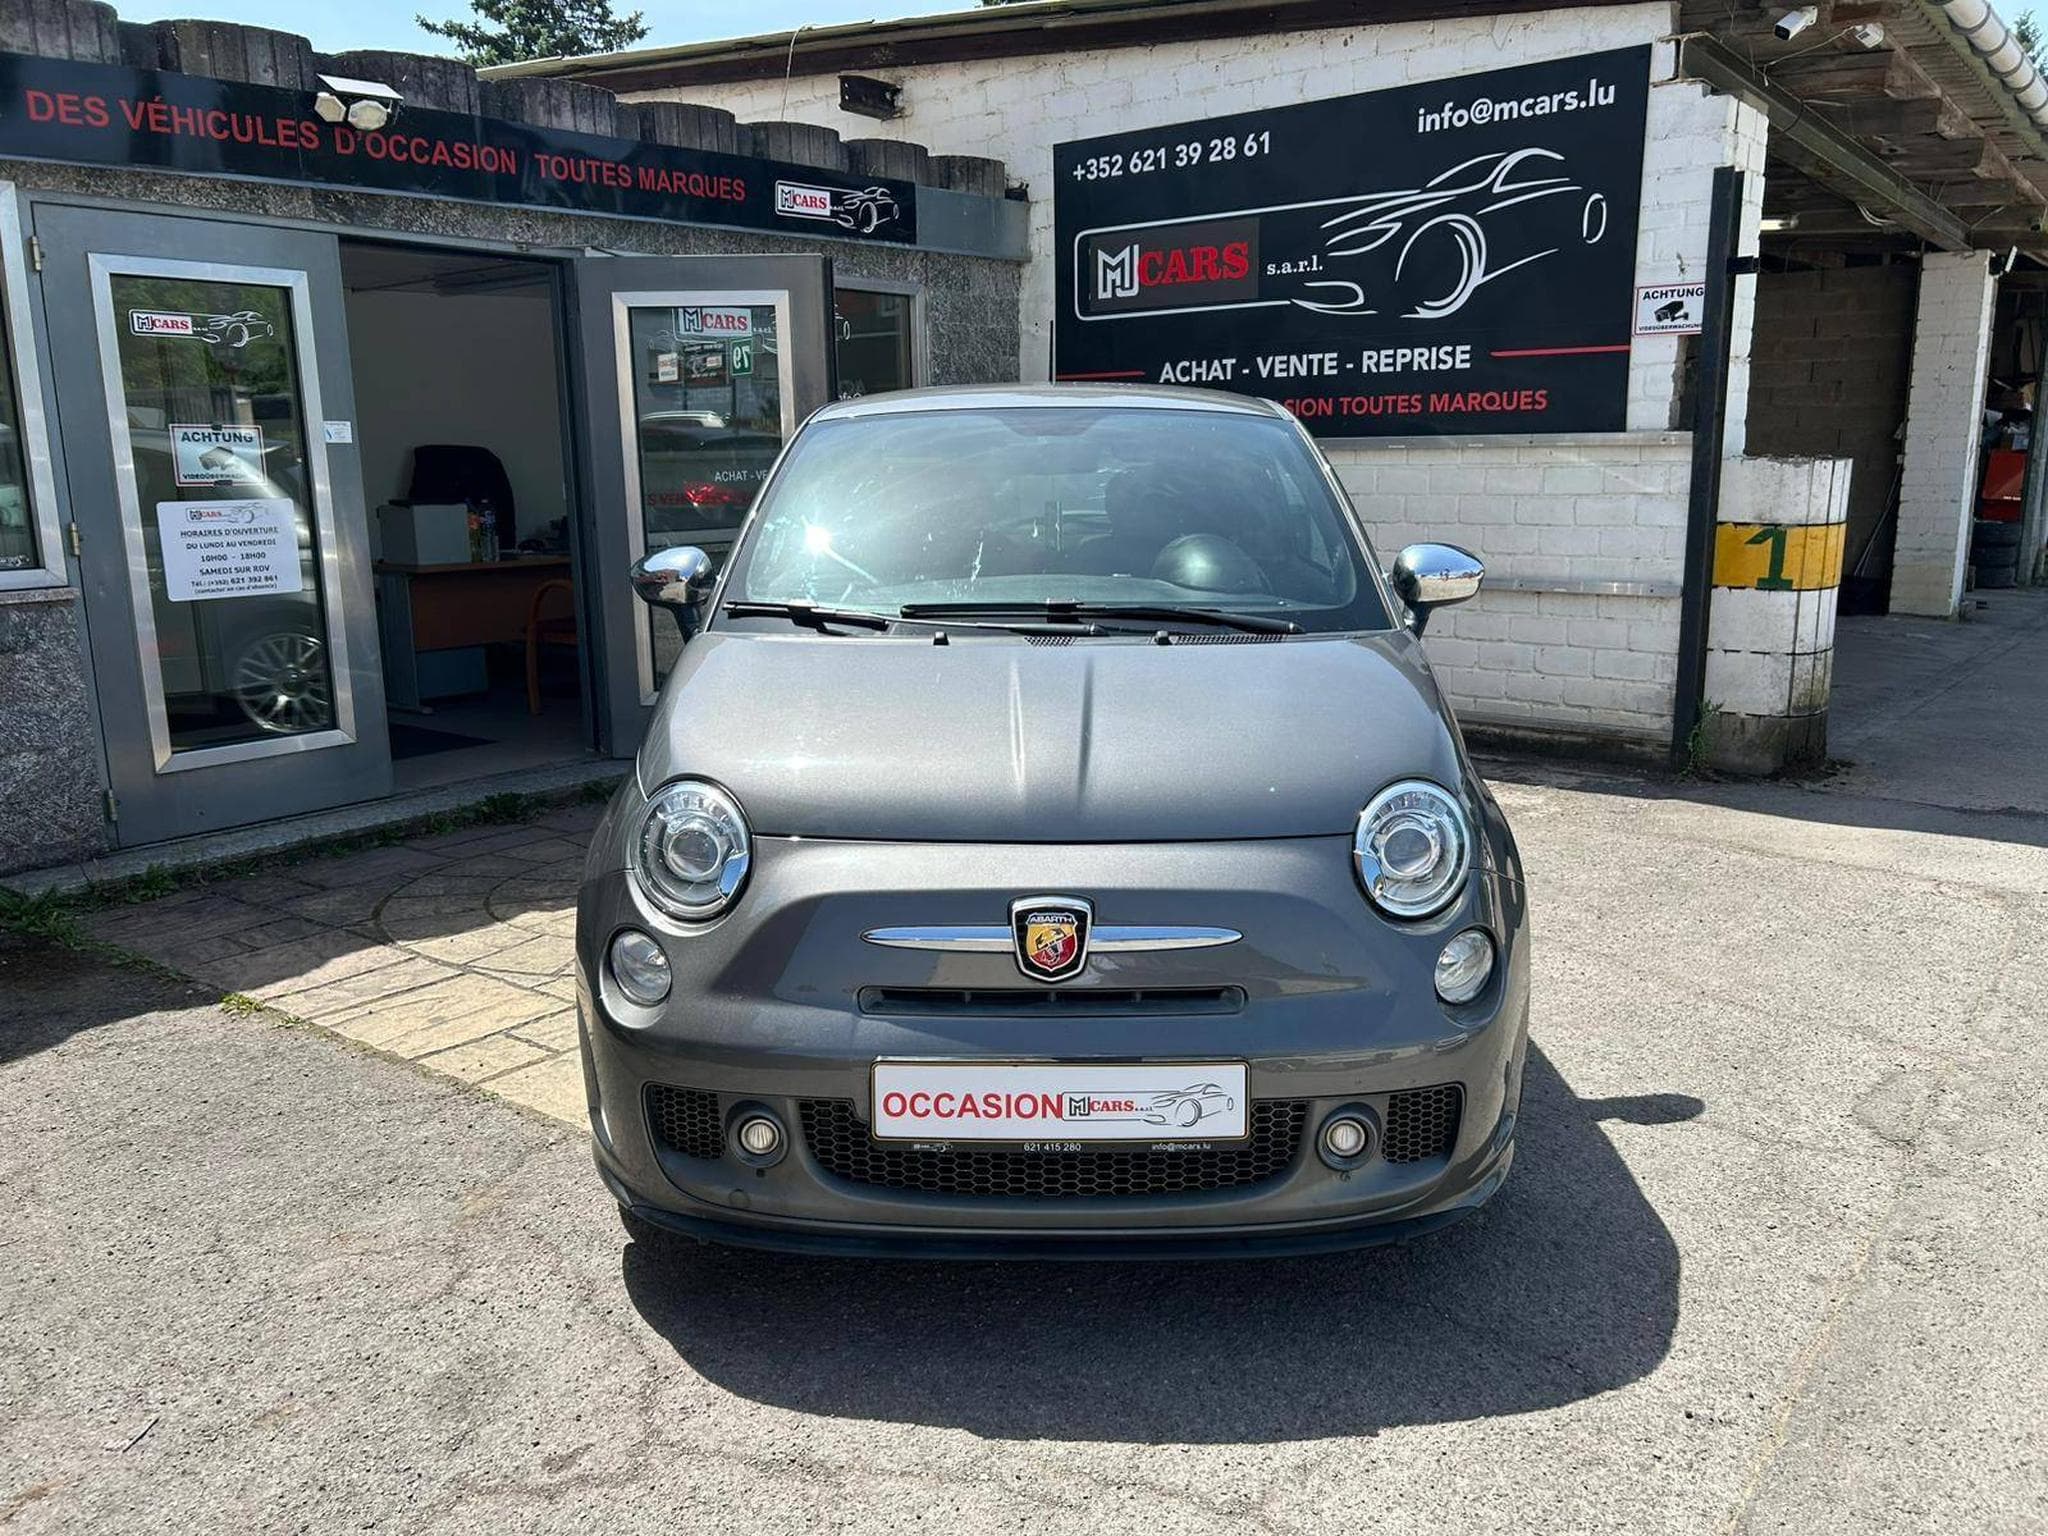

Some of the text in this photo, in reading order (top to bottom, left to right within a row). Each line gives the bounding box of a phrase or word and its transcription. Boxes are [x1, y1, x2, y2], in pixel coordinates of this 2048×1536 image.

[1417, 78, 1616, 133] info@mcars.lu
[25, 90, 747, 201] DES VÉHICULES D'OCCASION TOUTES MARQUES
[1073, 131, 1271, 181] +352 621 39 28 61
[1266, 254, 1324, 276] s.a.r.l.
[1642, 286, 1704, 301] ACHTUNG
[1158, 358, 1237, 384] ACHAT
[1256, 352, 1339, 379] VENTE
[1361, 344, 1472, 374] REPRISE
[1339, 394, 1422, 416] TOUTES
[1429, 389, 1549, 413] MARQUES
[180, 431, 254, 444] ACHTUNG
[714, 469, 748, 482] ACHAT
[180, 526, 279, 538] HORAIRES D'OUVERTURE
[186, 538, 276, 550] DU LUNDI AU VENDREDI
[201, 554, 228, 562] 10H00
[1744, 527, 1793, 591] 1
[200, 564, 270, 577] SAMEDI SUR RDV
[1030, 915, 1072, 923] ABARTH
[882, 1091, 1064, 1119] OCCASION
[1023, 1143, 1082, 1152] 621 415 280
